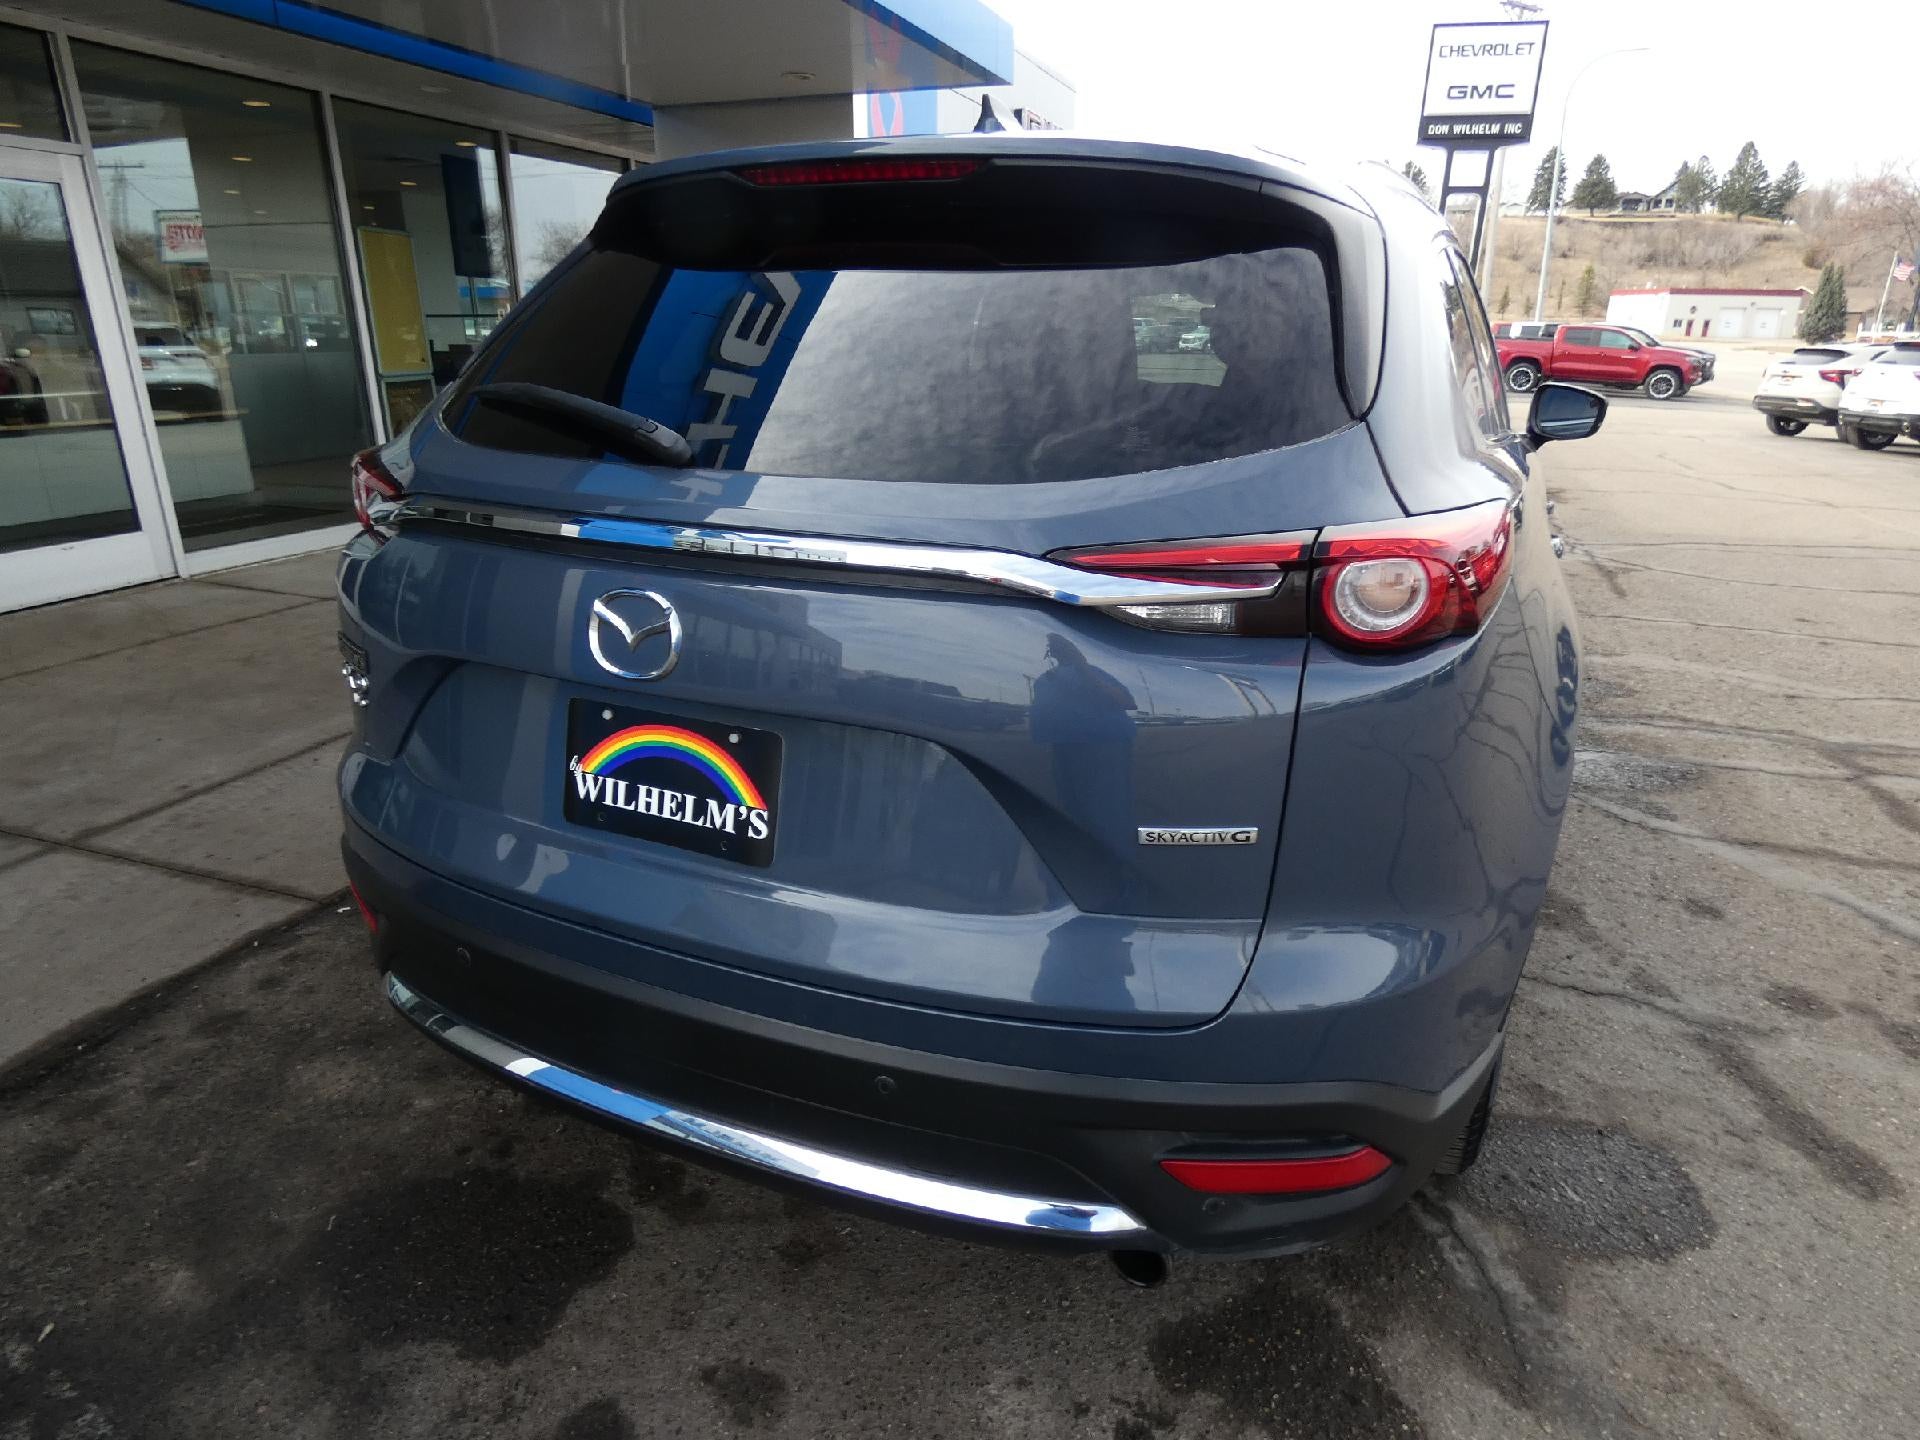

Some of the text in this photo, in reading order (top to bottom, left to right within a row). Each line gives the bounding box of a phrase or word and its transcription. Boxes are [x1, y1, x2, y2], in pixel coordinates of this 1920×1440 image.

[1439, 42, 1536, 58] CHEVROLET
[1447, 84, 1515, 100] GMC
[1428, 122, 1522, 135] DON WILHELM INC
[569, 755, 584, 777] by
[575, 773, 769, 839] WILHELM'S
